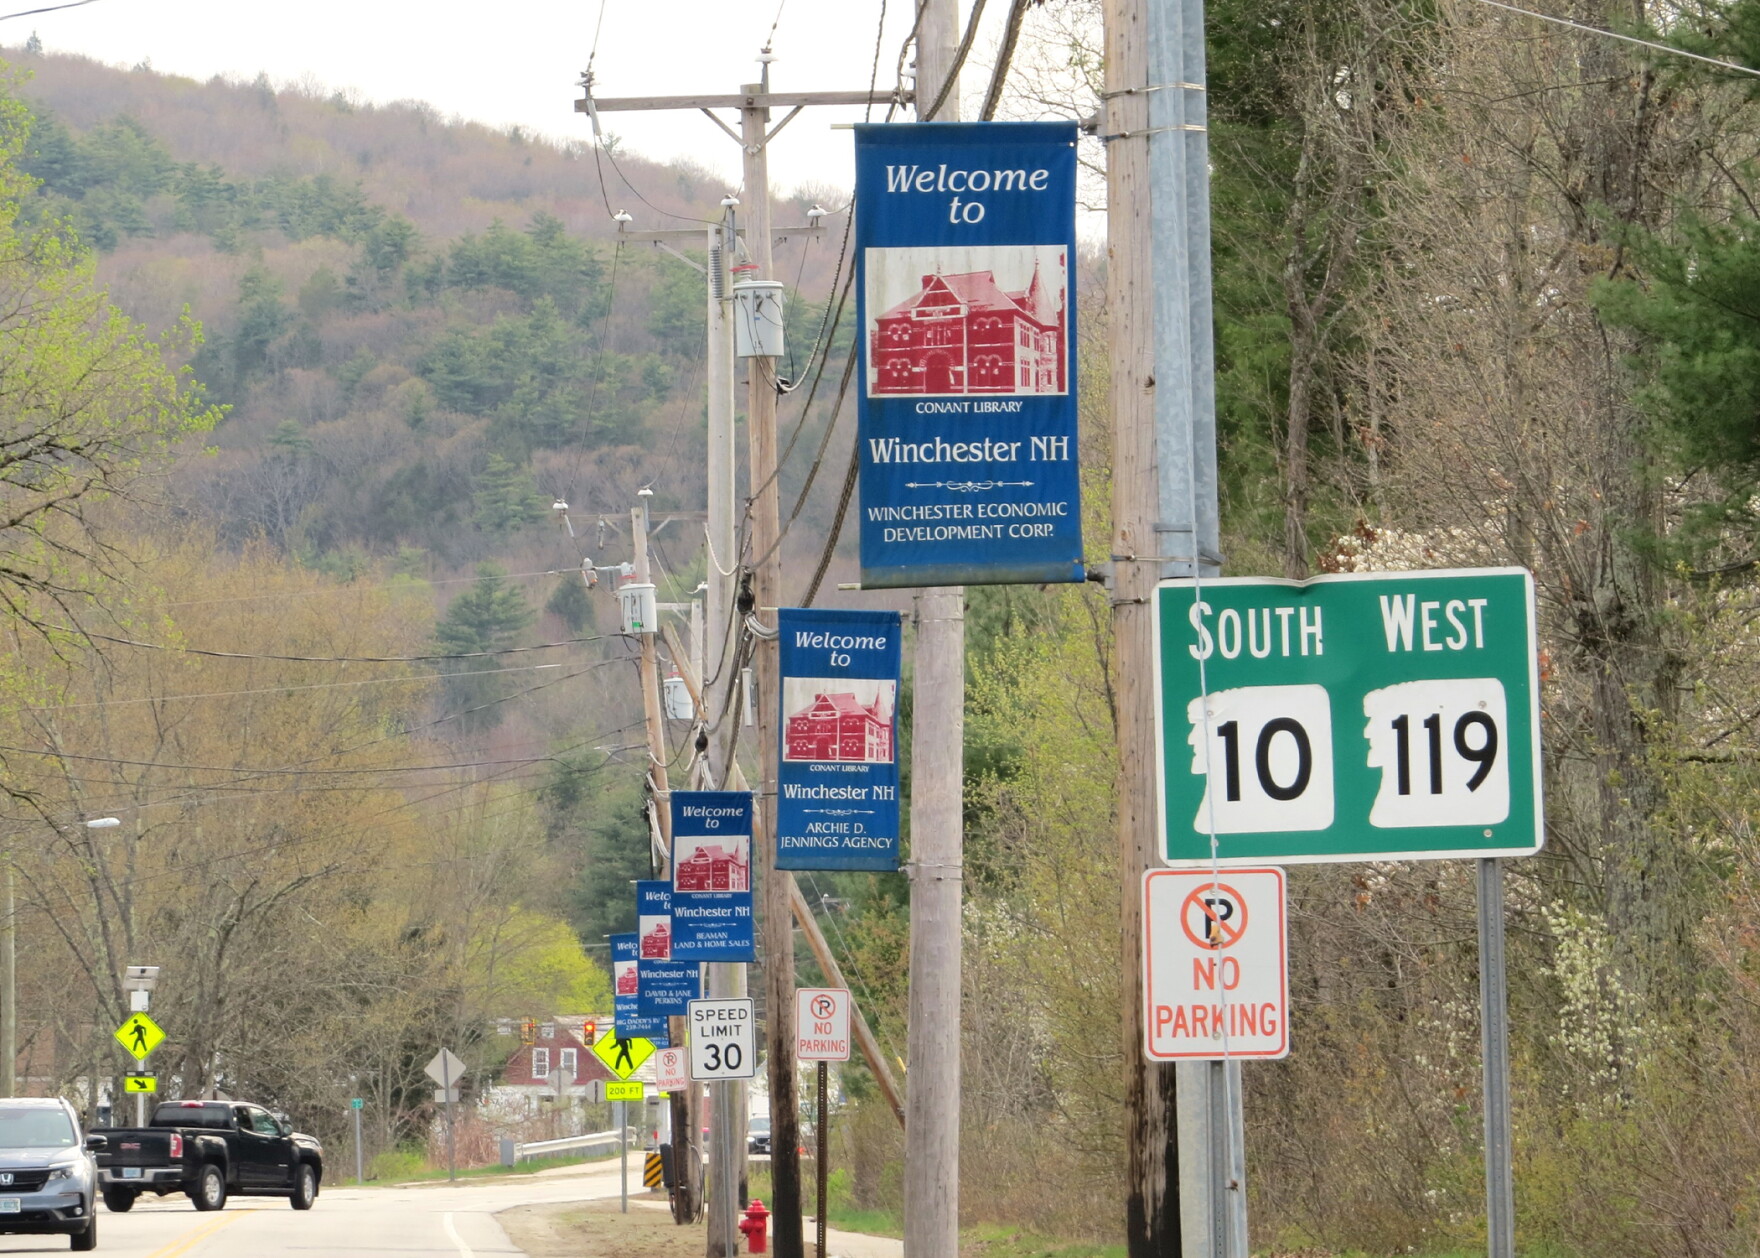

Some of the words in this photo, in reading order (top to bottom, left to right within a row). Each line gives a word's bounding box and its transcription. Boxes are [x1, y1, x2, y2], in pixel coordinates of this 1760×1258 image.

[886, 164, 1049, 193] Welcome
[949, 197, 985, 224] to
[916, 402, 970, 414] CONANT
[974, 401, 1023, 413] LIBRARY
[869, 437, 1021, 464] Winchester
[1030, 436, 1069, 461] NH
[868, 504, 974, 521] WINCHESTER
[978, 502, 1067, 517] ECONOMIC
[884, 524, 1004, 542] DEVELOPMENT
[1009, 523, 1054, 538] CORP.
[1188, 600, 1323, 660] SOUTH
[1379, 593, 1488, 653] WEST
[796, 632, 886, 649] Welcome
[830, 651, 851, 666] to
[1217, 717, 1312, 802] 10
[1391, 710, 1498, 796] 119
[783, 784, 868, 799] Winchester
[873, 786, 895, 800] NH
[683, 806, 744, 817] Welcome
[705, 817, 720, 829] to
[806, 822, 849, 833] ARCHIE
[854, 823, 866, 834] D.
[781, 836, 839, 848] JENNINGS
[841, 837, 893, 848] AGENCY
[674, 906, 732, 918] Winchester
[735, 906, 750, 917] NH
[696, 932, 728, 940] BEAMAN
[674, 941, 696, 949] LAND
[704, 940, 727, 948] HOME
[640, 969, 684, 979] Winchester
[686, 969, 699, 978] NH
[1193, 956, 1240, 991] NO
[695, 1008, 748, 1022] SPEED
[1156, 1002, 1277, 1038] PARKING
[701, 1024, 742, 1038] LIMIT
[814, 1021, 833, 1035] NO
[800, 1039, 846, 1053] PARKING
[704, 1043, 742, 1071] 30
[665, 1068, 676, 1076] NO
[659, 1077, 685, 1087] PARKING
[609, 1087, 626, 1095] 200
[629, 1087, 639, 1095] FT
